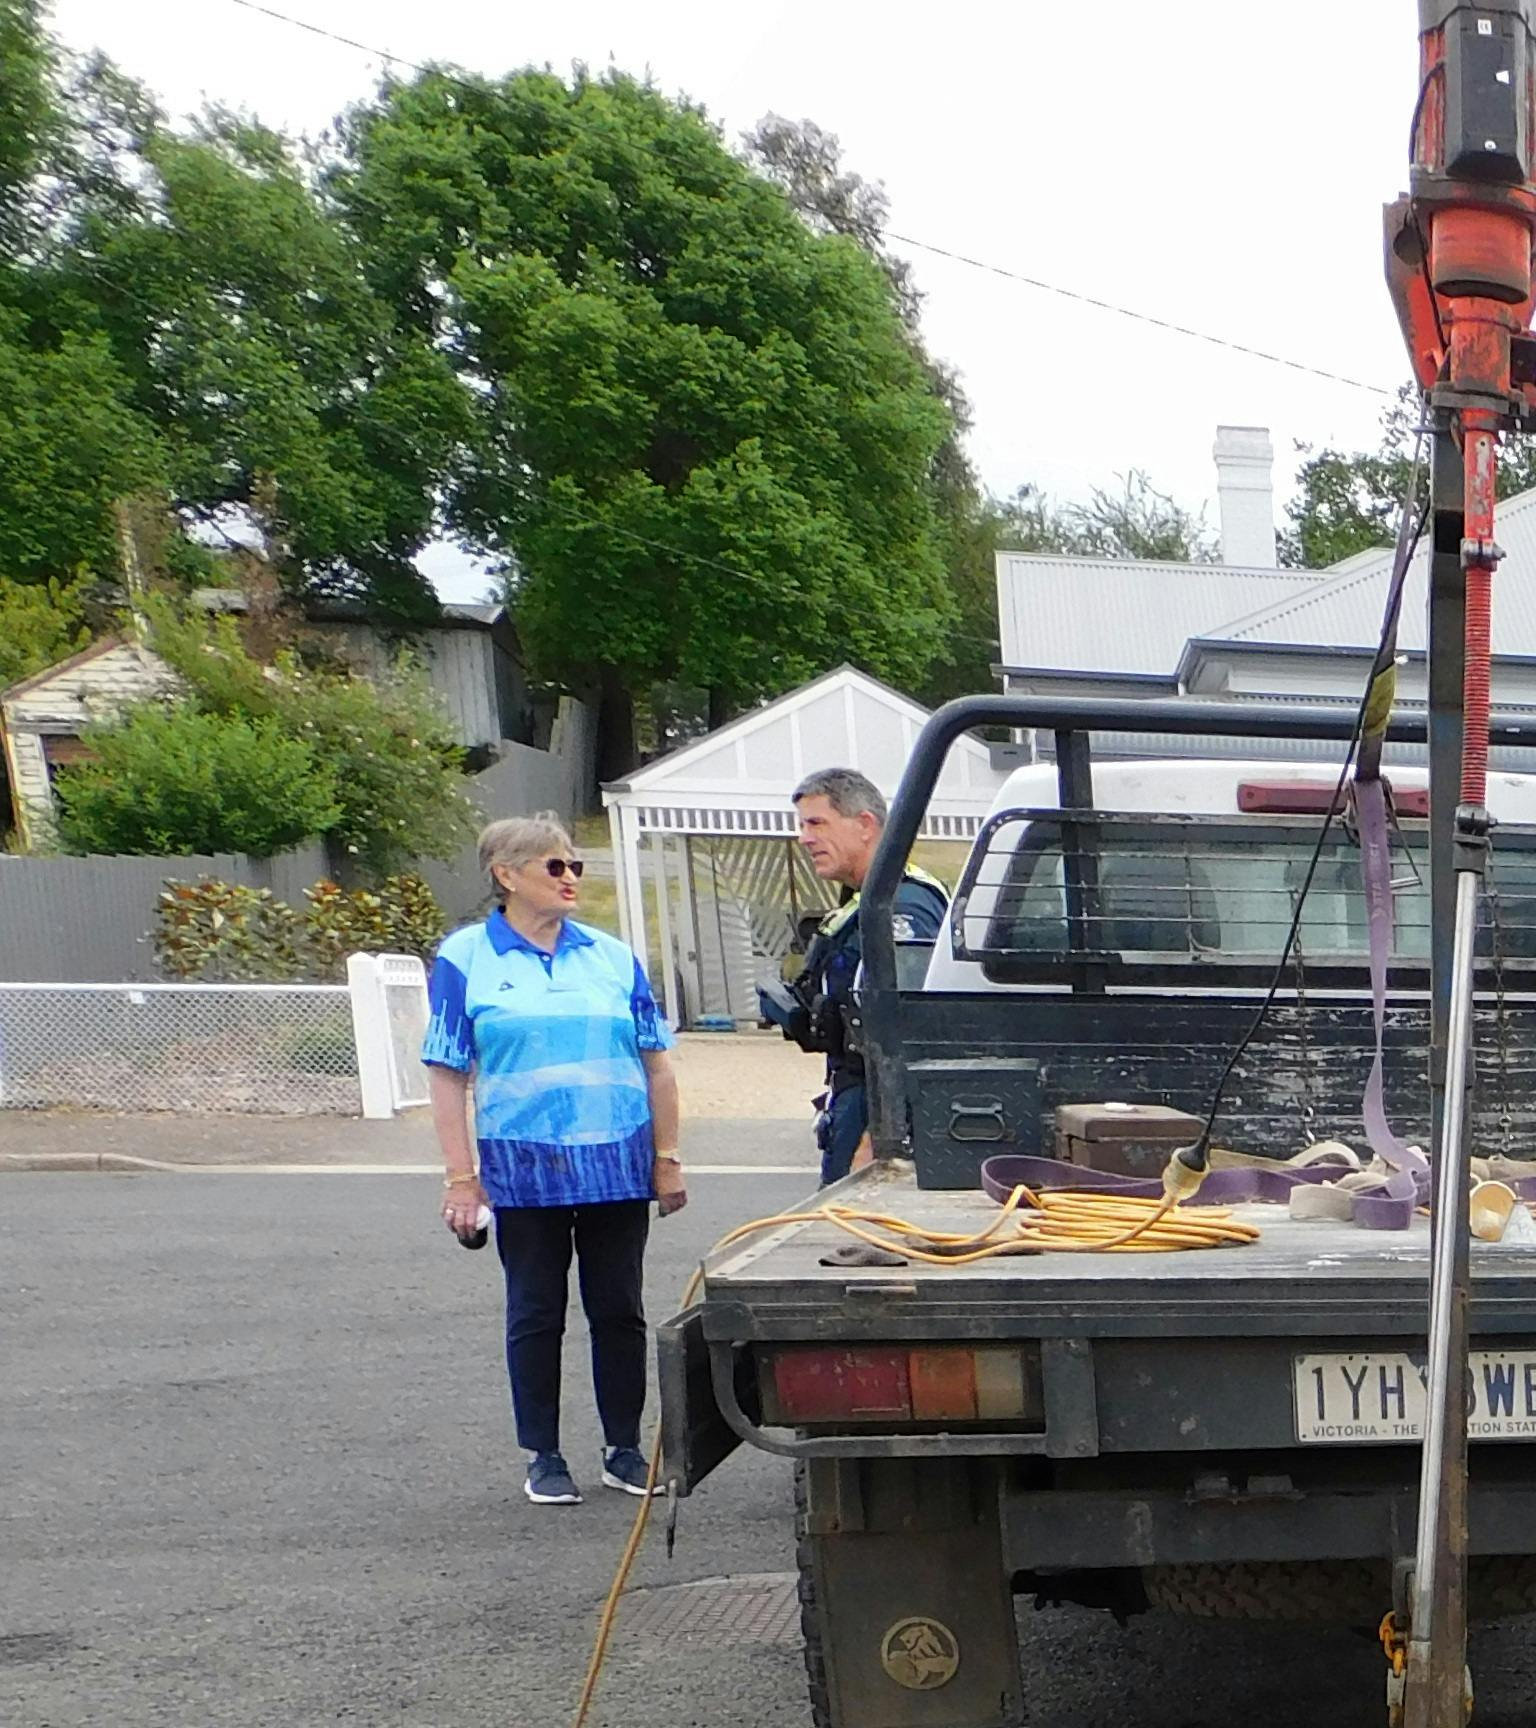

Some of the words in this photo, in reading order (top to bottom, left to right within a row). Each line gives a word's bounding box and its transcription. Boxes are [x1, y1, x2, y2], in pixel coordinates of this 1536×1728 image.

[1312, 1365, 1405, 1420] 1YH
[1312, 1425, 1378, 1437] VICTORIA
[1393, 1424, 1419, 1435] THE
